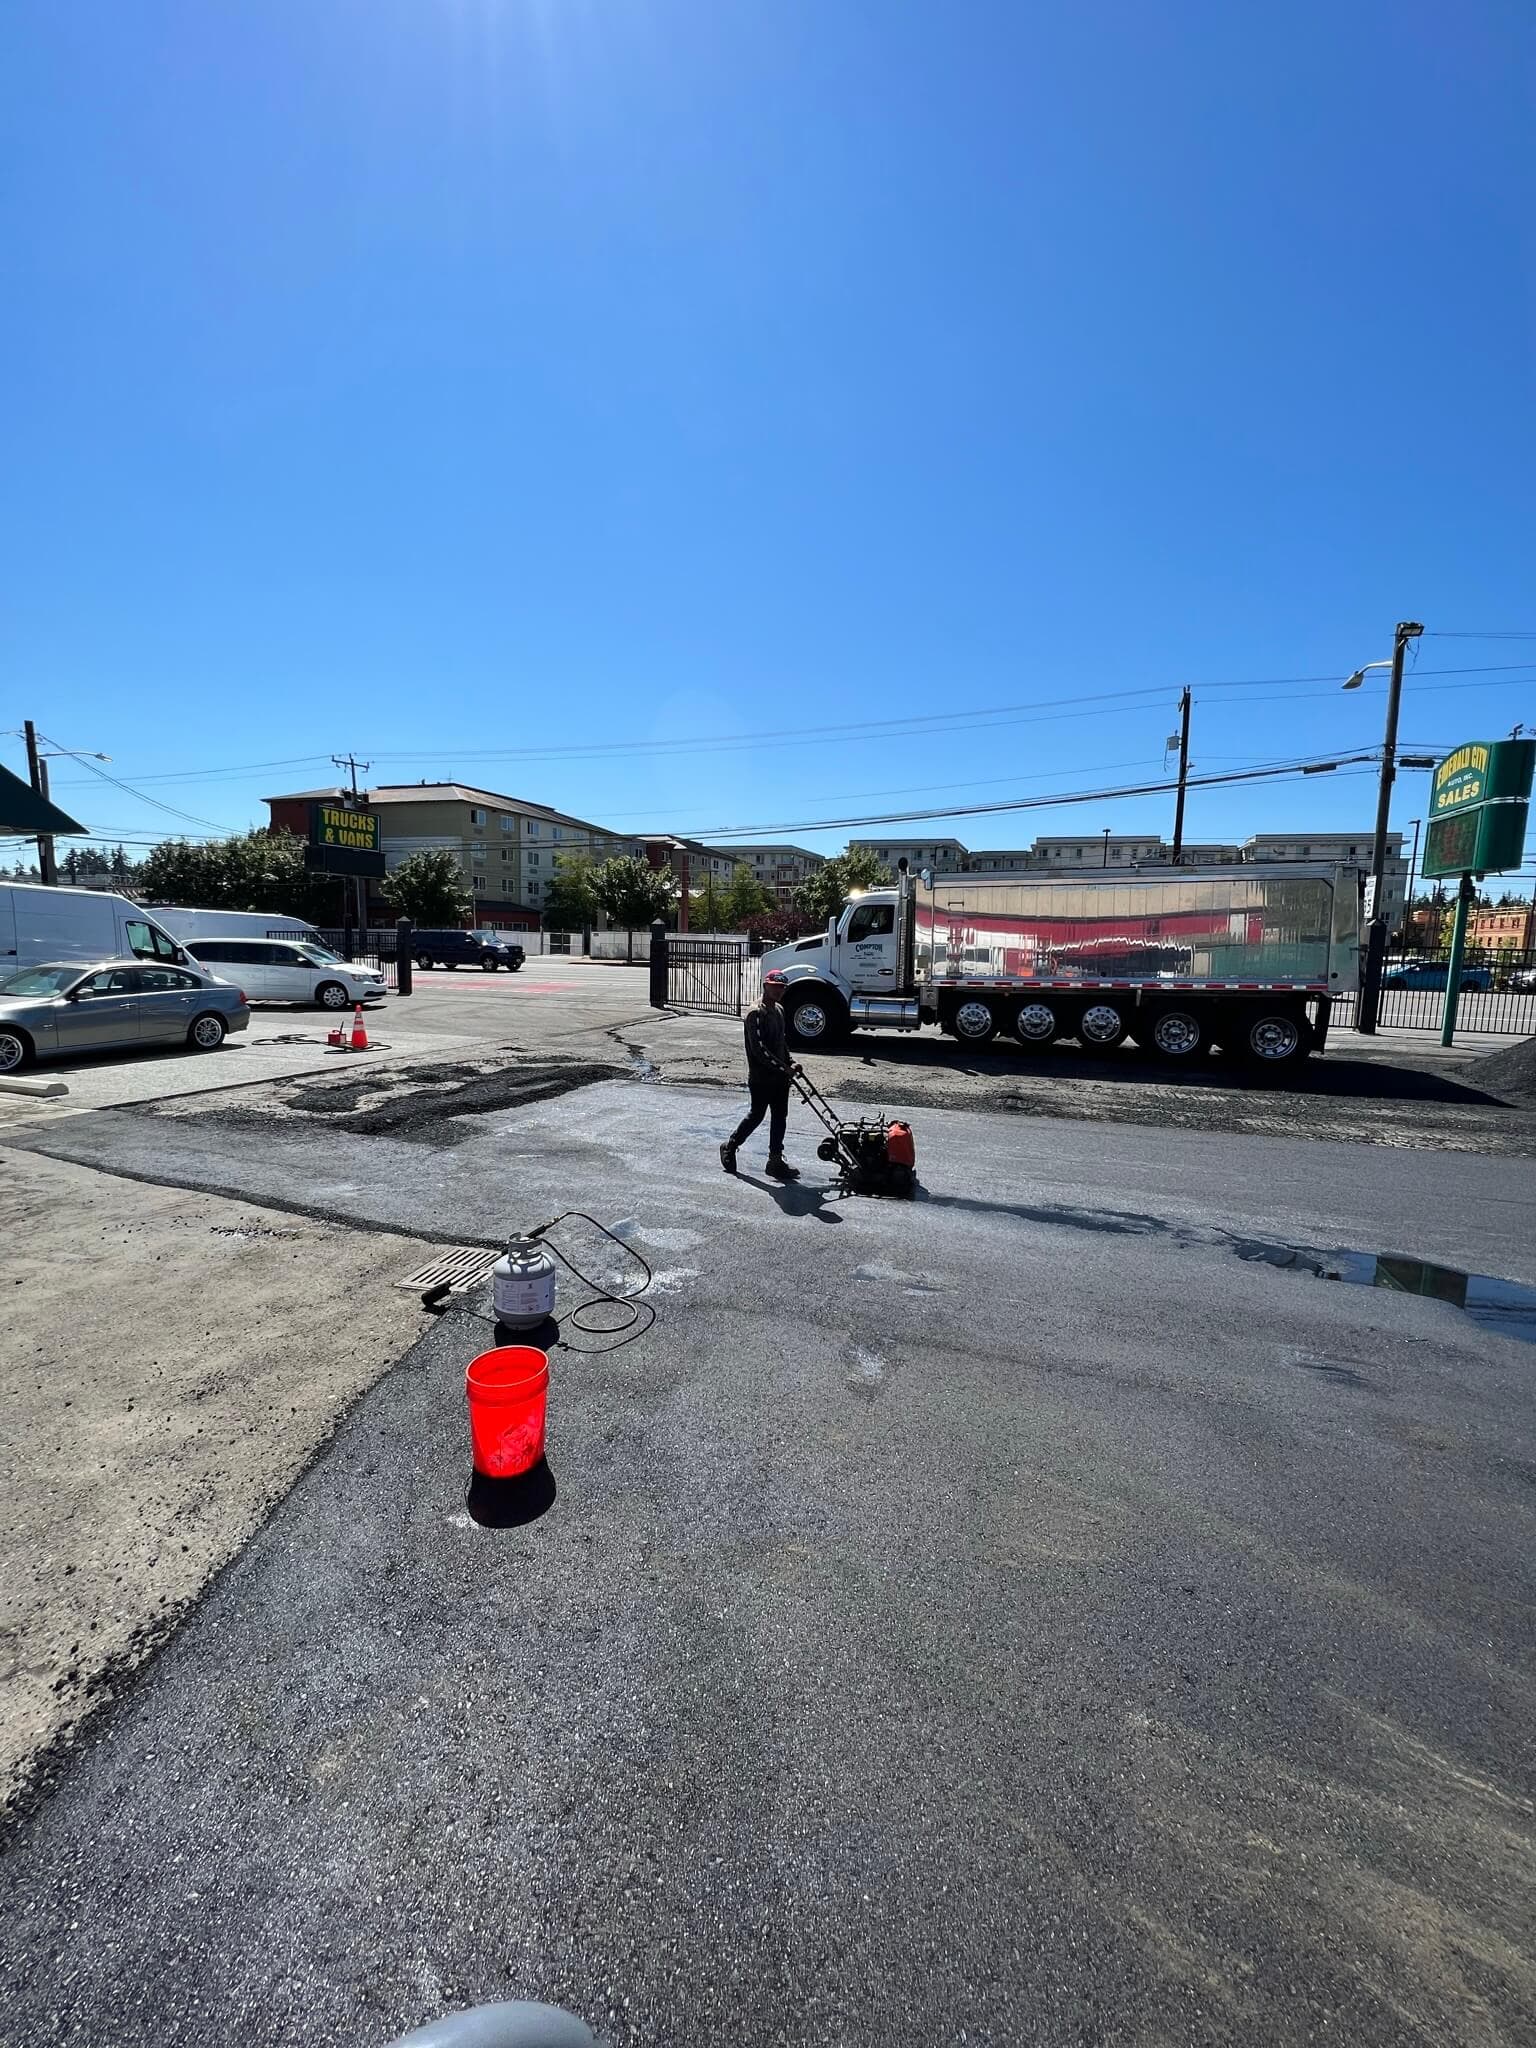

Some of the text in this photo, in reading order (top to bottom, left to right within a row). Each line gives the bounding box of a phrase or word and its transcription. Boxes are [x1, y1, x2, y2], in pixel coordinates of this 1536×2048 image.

[1436, 746, 1488, 791] EMERALD CITY
[1437, 781, 1480, 808] SALES
[322, 808, 375, 832] TRUCKS
[325, 827, 374, 849] & VANS
